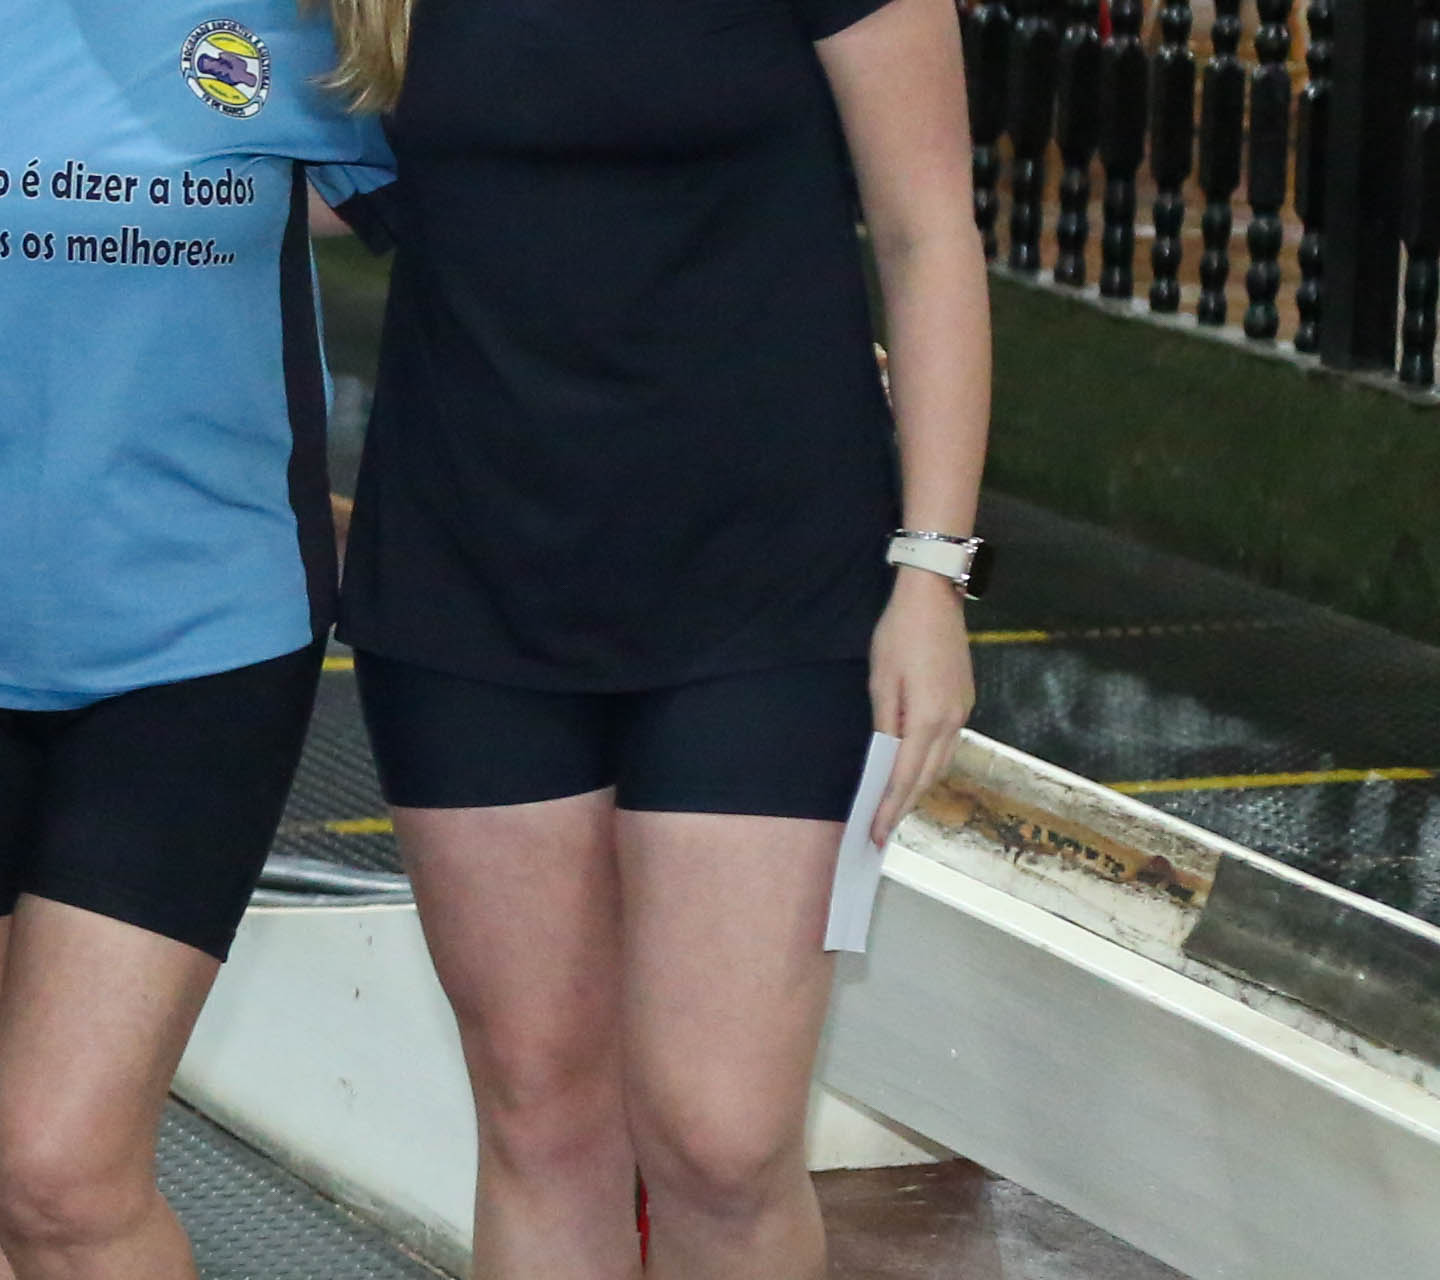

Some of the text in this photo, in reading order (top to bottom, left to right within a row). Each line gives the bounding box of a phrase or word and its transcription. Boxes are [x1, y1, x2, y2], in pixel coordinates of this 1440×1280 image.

[21, 158, 41, 198] é
[51, 160, 138, 202] dizer
[149, 176, 170, 205] a
[182, 168, 256, 207] todos
[22, 231, 55, 260] os
[66, 225, 236, 267] melhores...
